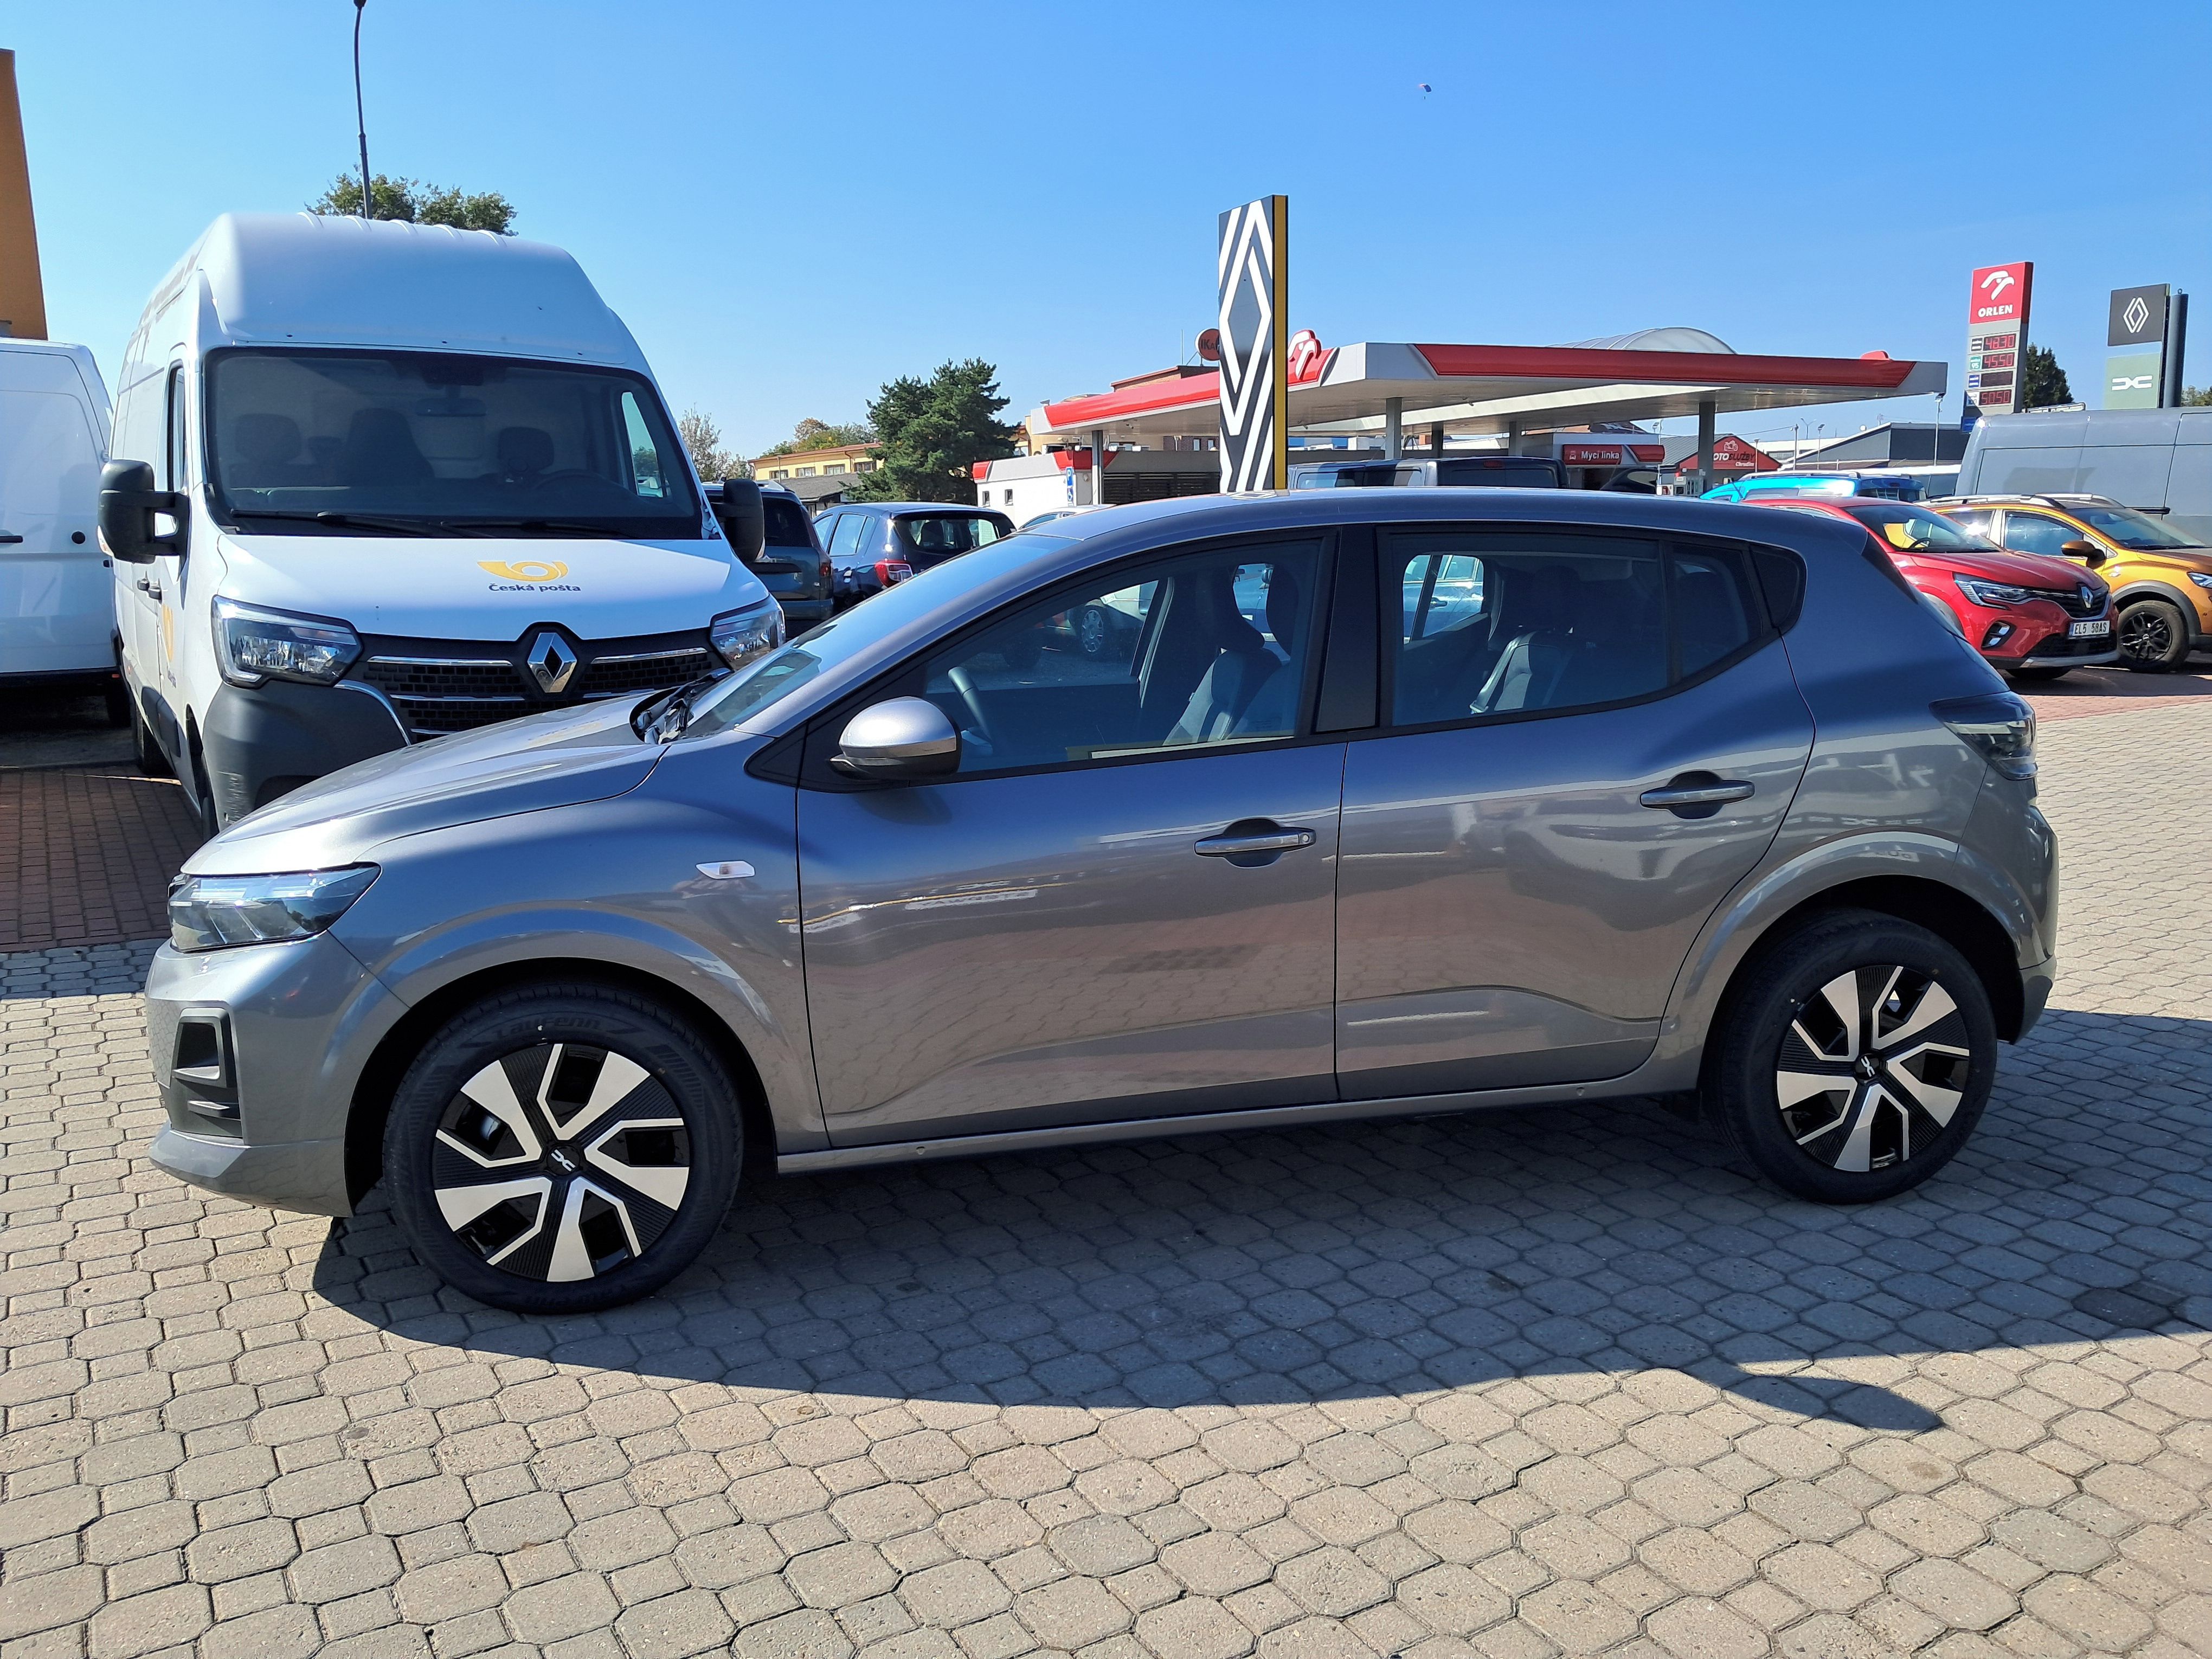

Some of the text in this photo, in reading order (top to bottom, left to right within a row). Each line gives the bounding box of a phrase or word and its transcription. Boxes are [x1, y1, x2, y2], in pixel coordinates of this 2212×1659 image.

[1978, 304, 2013, 318] ORLEN
[1981, 390, 2010, 404] 5050
[1713, 451, 1756, 461] OTOSLUŽBY
[488, 583, 581, 592] Česká pošta
